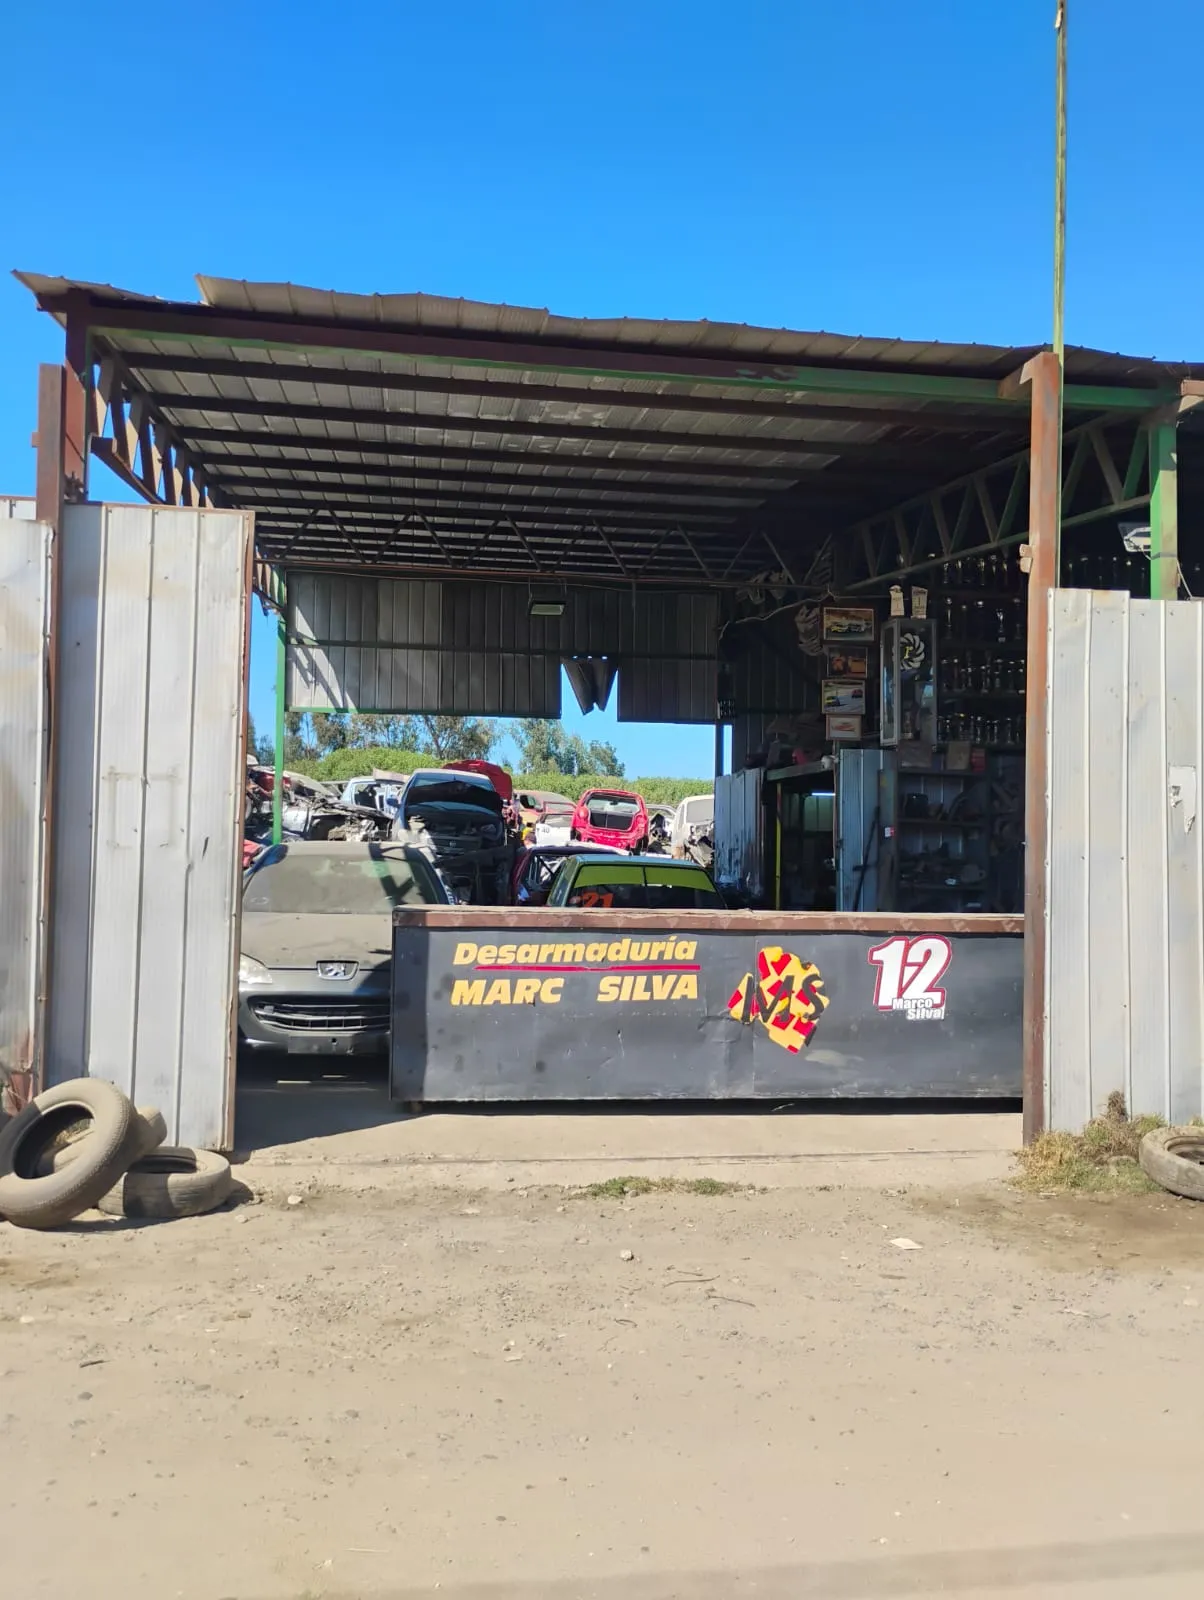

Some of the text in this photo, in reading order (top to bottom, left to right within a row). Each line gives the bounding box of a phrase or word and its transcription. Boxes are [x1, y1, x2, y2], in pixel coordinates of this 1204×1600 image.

[453, 936, 698, 965] Desarmaduría
[868, 934, 952, 1011] 12
[597, 974, 698, 1002] SILVA
[892, 997, 933, 1010] Marco
